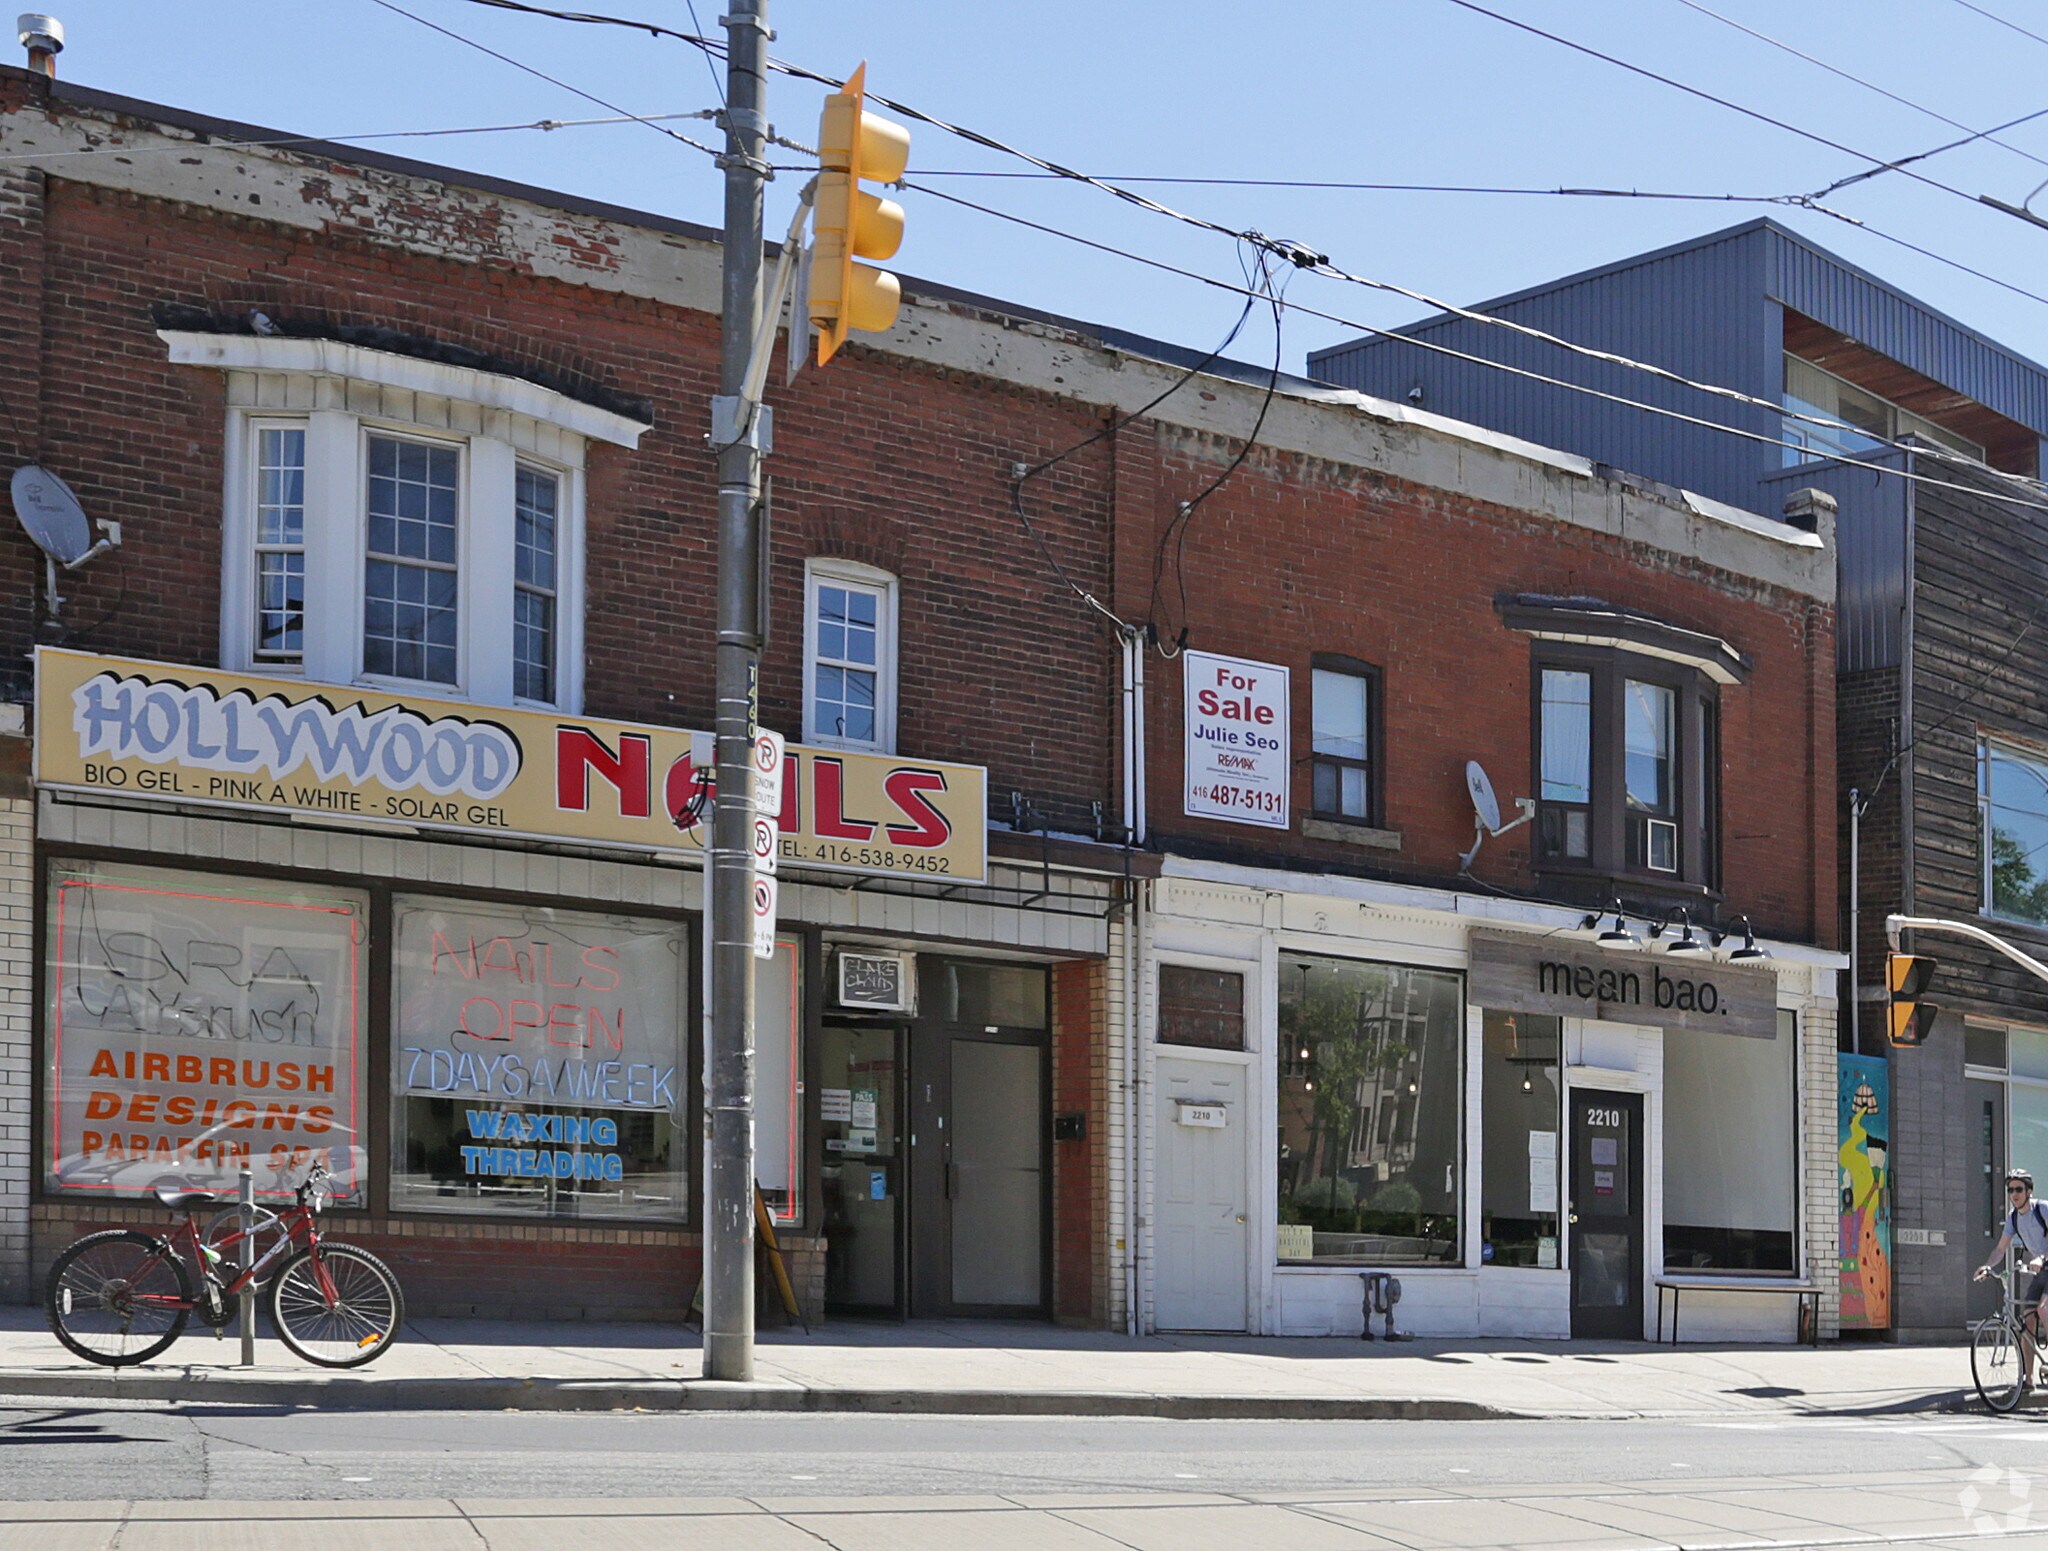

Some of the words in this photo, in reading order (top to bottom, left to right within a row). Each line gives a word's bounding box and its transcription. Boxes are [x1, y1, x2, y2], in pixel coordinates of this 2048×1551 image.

[1217, 668, 1257, 691] For
[1198, 689, 1274, 725] Sale
[76, 676, 514, 796] HOLLYWOOD
[1194, 724, 1239, 744] Julie
[1245, 732, 1279, 751] Seo
[1217, 753, 1256, 771] RE/MAX
[85, 764, 127, 786] BIO
[137, 770, 184, 793] GEL
[209, 777, 263, 801] PINK
[269, 785, 287, 804] A
[293, 786, 361, 812] WHITE
[386, 796, 459, 823] SOLAR
[466, 805, 510, 827] GEL
[1192, 785, 1208, 798] 416
[1210, 784, 1282, 813] 487-5131
[815, 844, 950, 874] 416-538-9452
[431, 932, 622, 991] NAILS
[1539, 960, 1640, 1005] mean
[1654, 966, 1727, 1015] bao.
[459, 997, 623, 1050] OPEN
[89, 1050, 334, 1092] AIRBRUSH
[430, 1050, 523, 1097] DAYS
[563, 1060, 676, 1106] WEEK
[85, 1091, 334, 1133] DESIGNS
[466, 1110, 618, 1147] WAXING
[1192, 1111, 1211, 1120] 2210
[1587, 1108, 1620, 1127] 2210
[82, 1131, 249, 1169] PARAFFIN
[460, 1146, 623, 1181] THREADING
